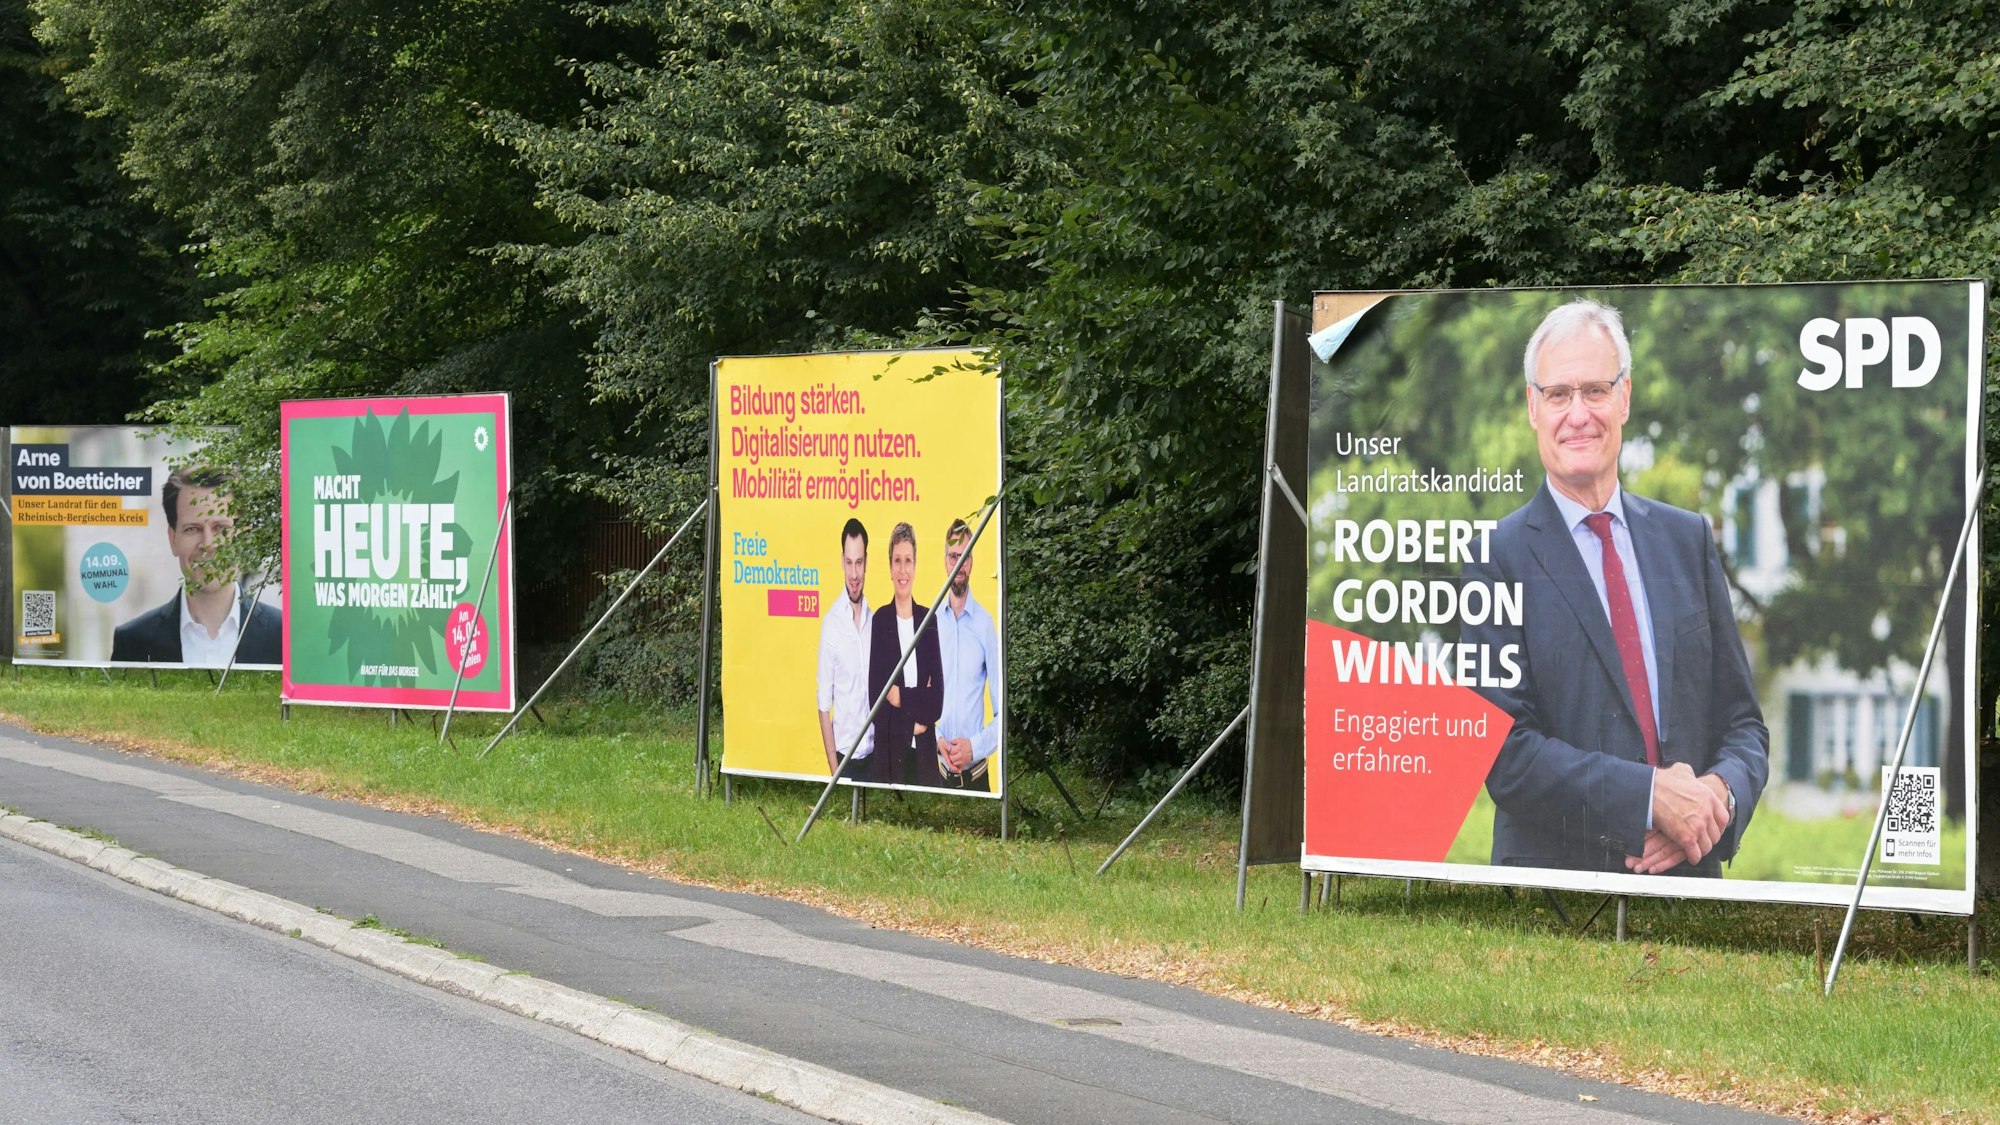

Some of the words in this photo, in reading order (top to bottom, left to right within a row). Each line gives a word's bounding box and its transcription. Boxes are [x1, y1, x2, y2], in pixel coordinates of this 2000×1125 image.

[1797, 316, 1942, 391] SPD
[730, 384, 796, 423] Bildung
[800, 383, 865, 415] stärken.
[731, 425, 849, 466] Digitalisierung
[854, 428, 921, 458] nutzen.
[1336, 432, 1401, 456] Unser
[17, 449, 60, 467] Arne
[17, 475, 50, 489] von
[53, 471, 144, 490] Boetticher
[314, 474, 361, 500] MACHT
[732, 467, 802, 499] Mobilität
[805, 468, 920, 510] ermöglichen.
[1337, 467, 1524, 493] Landratskandidat
[18, 500, 45, 509] Unser
[47, 499, 82, 509] Landrat
[84, 499, 98, 509] für
[100, 499, 117, 509] den
[18, 512, 116, 524] Rheinisch-Bergischen
[119, 513, 144, 523] Kreis
[313, 503, 468, 595] HEUTE,
[733, 531, 767, 556] Freie
[1334, 519, 1498, 563] ROBERT
[81, 568, 128, 580] KOMMUNAL
[85, 554, 122, 569] 14.09.
[733, 559, 819, 585] Demokraten
[93, 581, 118, 590] WAHL
[315, 582, 346, 607] WAS
[348, 582, 408, 608] MORGEN
[410, 578, 457, 609] ZÄHLT.
[797, 595, 818, 612] FDP
[1333, 579, 1524, 626] GORDON
[458, 611, 469, 624] Am
[360, 664, 378, 676] MACHT
[378, 663, 389, 677] FÜR
[388, 665, 399, 677] DAS
[1331, 640, 1522, 689] WINKELS
[1334, 708, 1440, 743] Engagiert
[1446, 712, 1488, 738] und
[1333, 746, 1432, 775] erfahren.
[1898, 838, 1926, 848] Scannen
[1927, 839, 1936, 848] für
[1898, 849, 1916, 858] mehr
[1916, 850, 1933, 858] Infos
